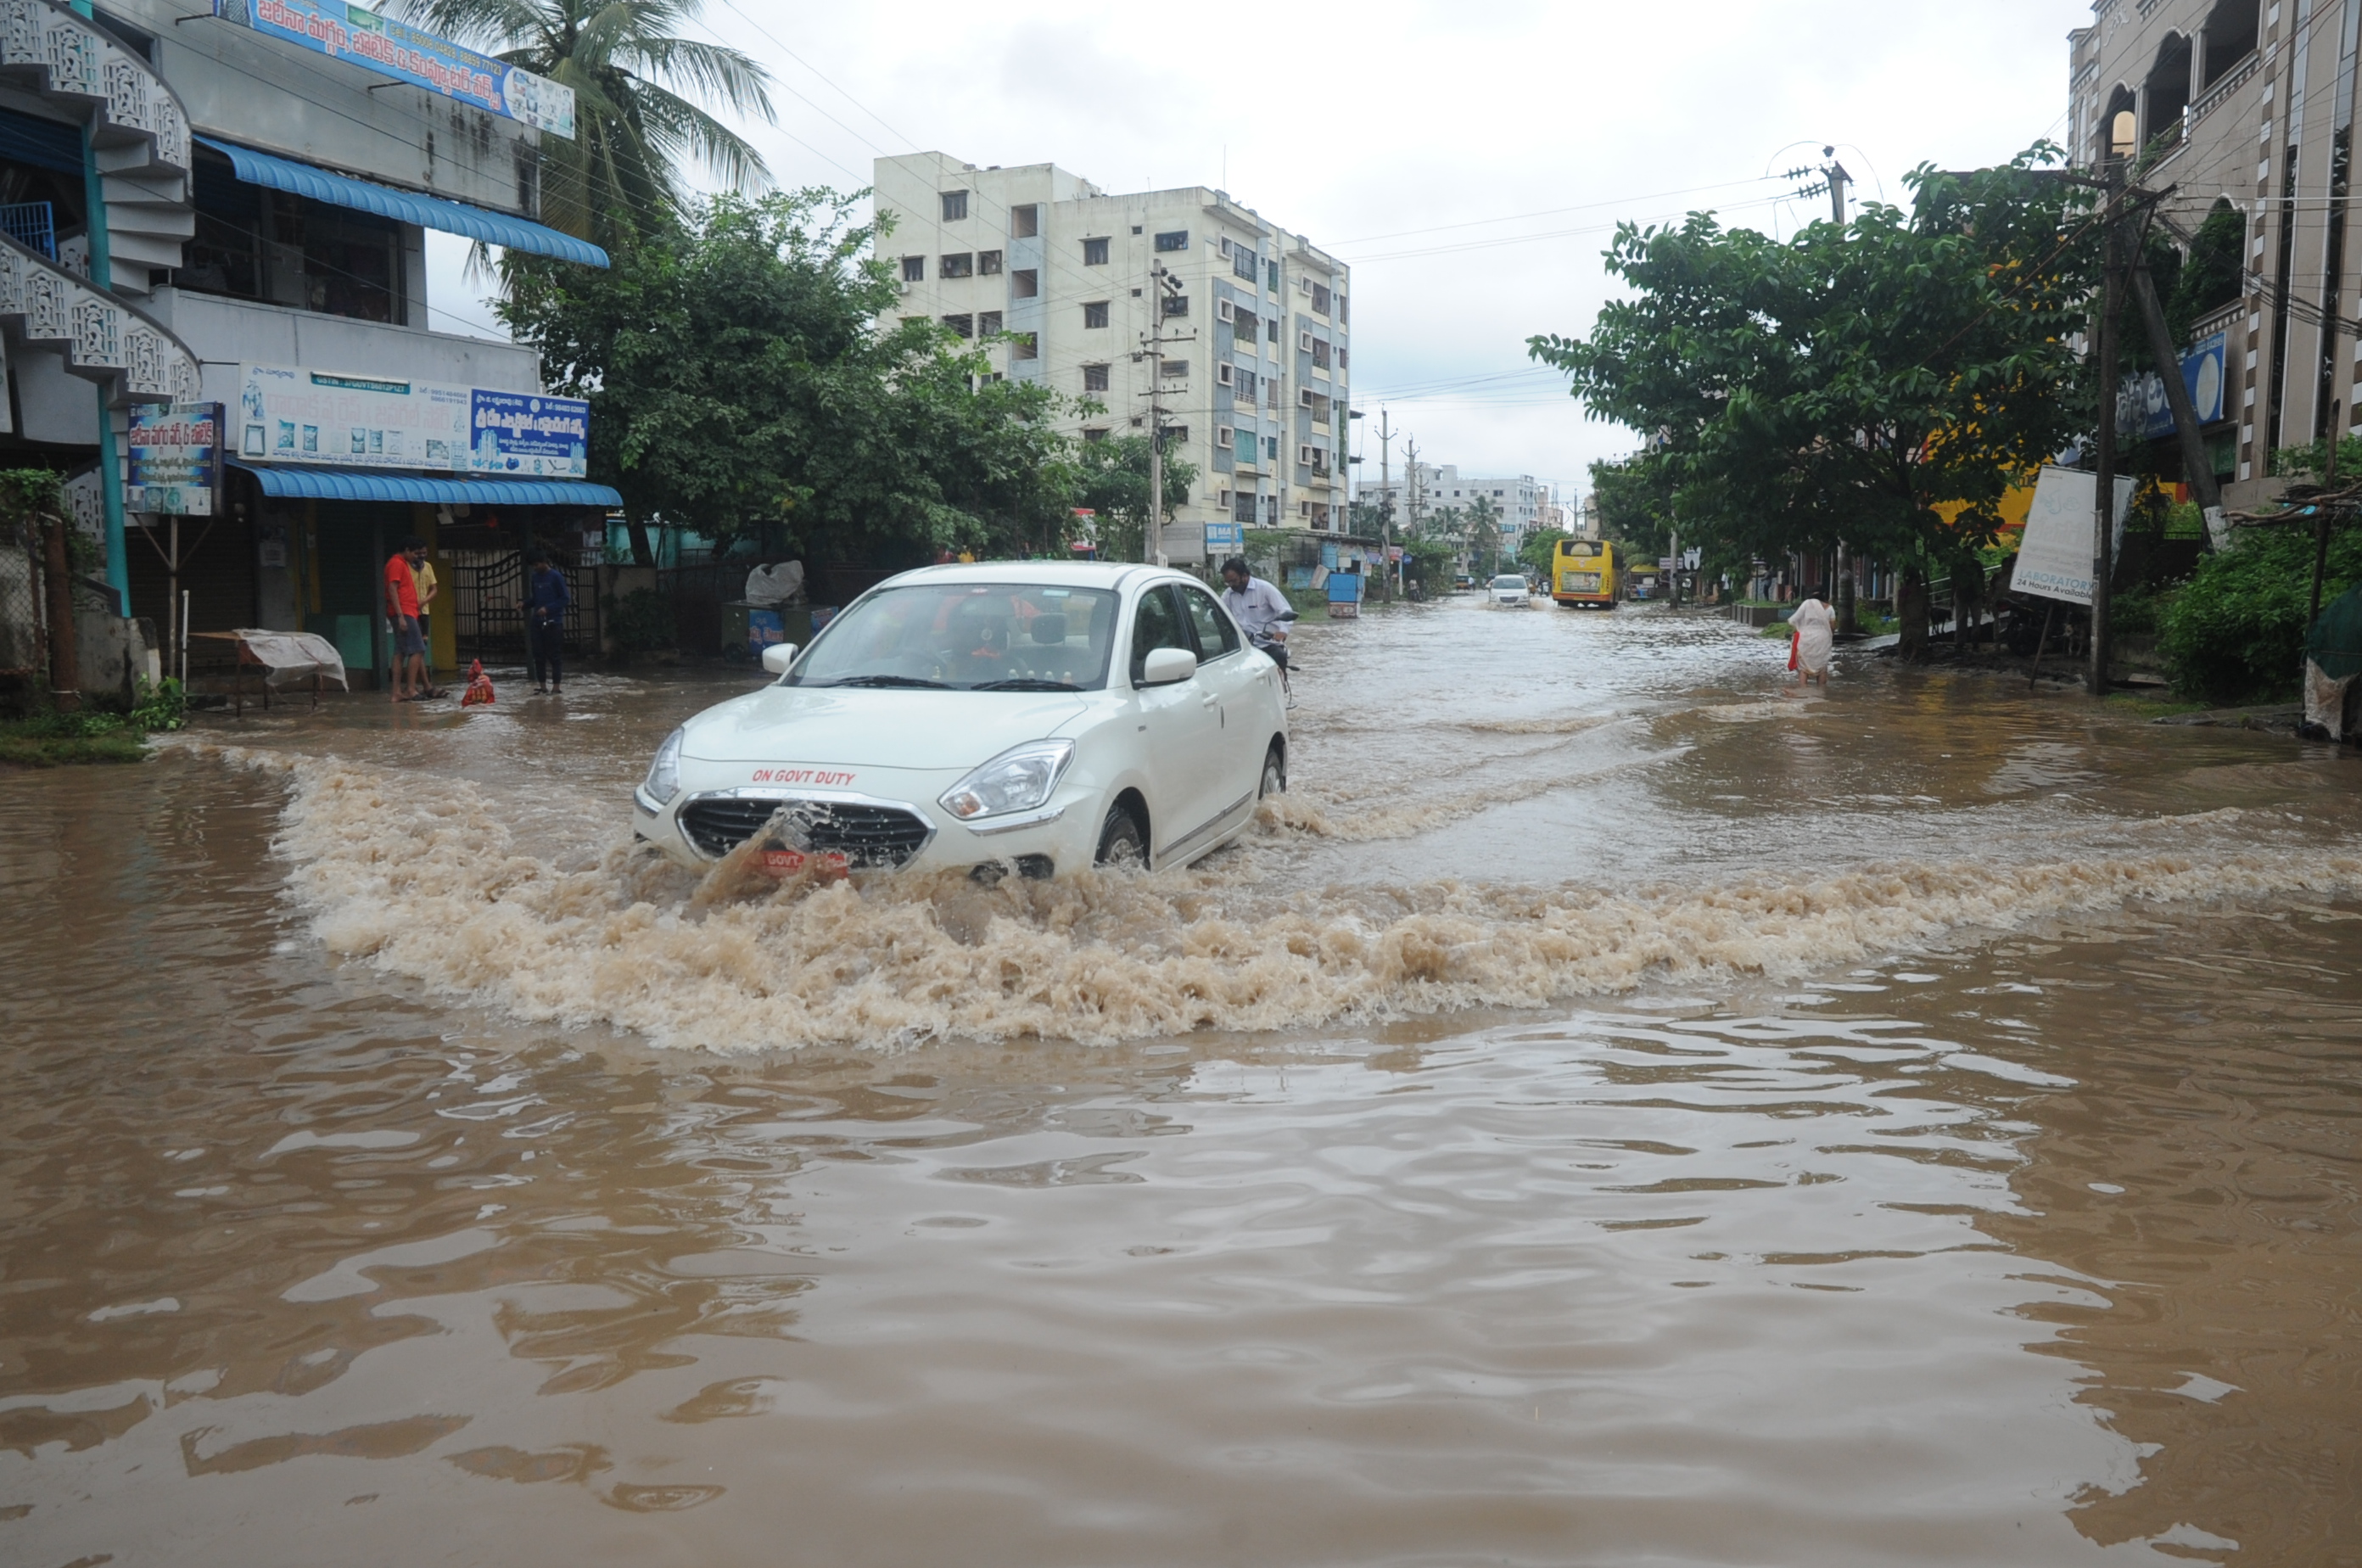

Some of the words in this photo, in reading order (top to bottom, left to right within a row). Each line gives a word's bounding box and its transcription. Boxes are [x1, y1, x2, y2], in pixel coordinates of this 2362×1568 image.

[389, 23, 406, 41] Cell
[2019, 568, 2095, 591] LABORATORY
[2029, 581, 2051, 591] Hours
[753, 770, 774, 781] ON
[775, 770, 814, 782] GOVT
[814, 771, 856, 786] DUTY
[766, 854, 799, 866] GOVT
